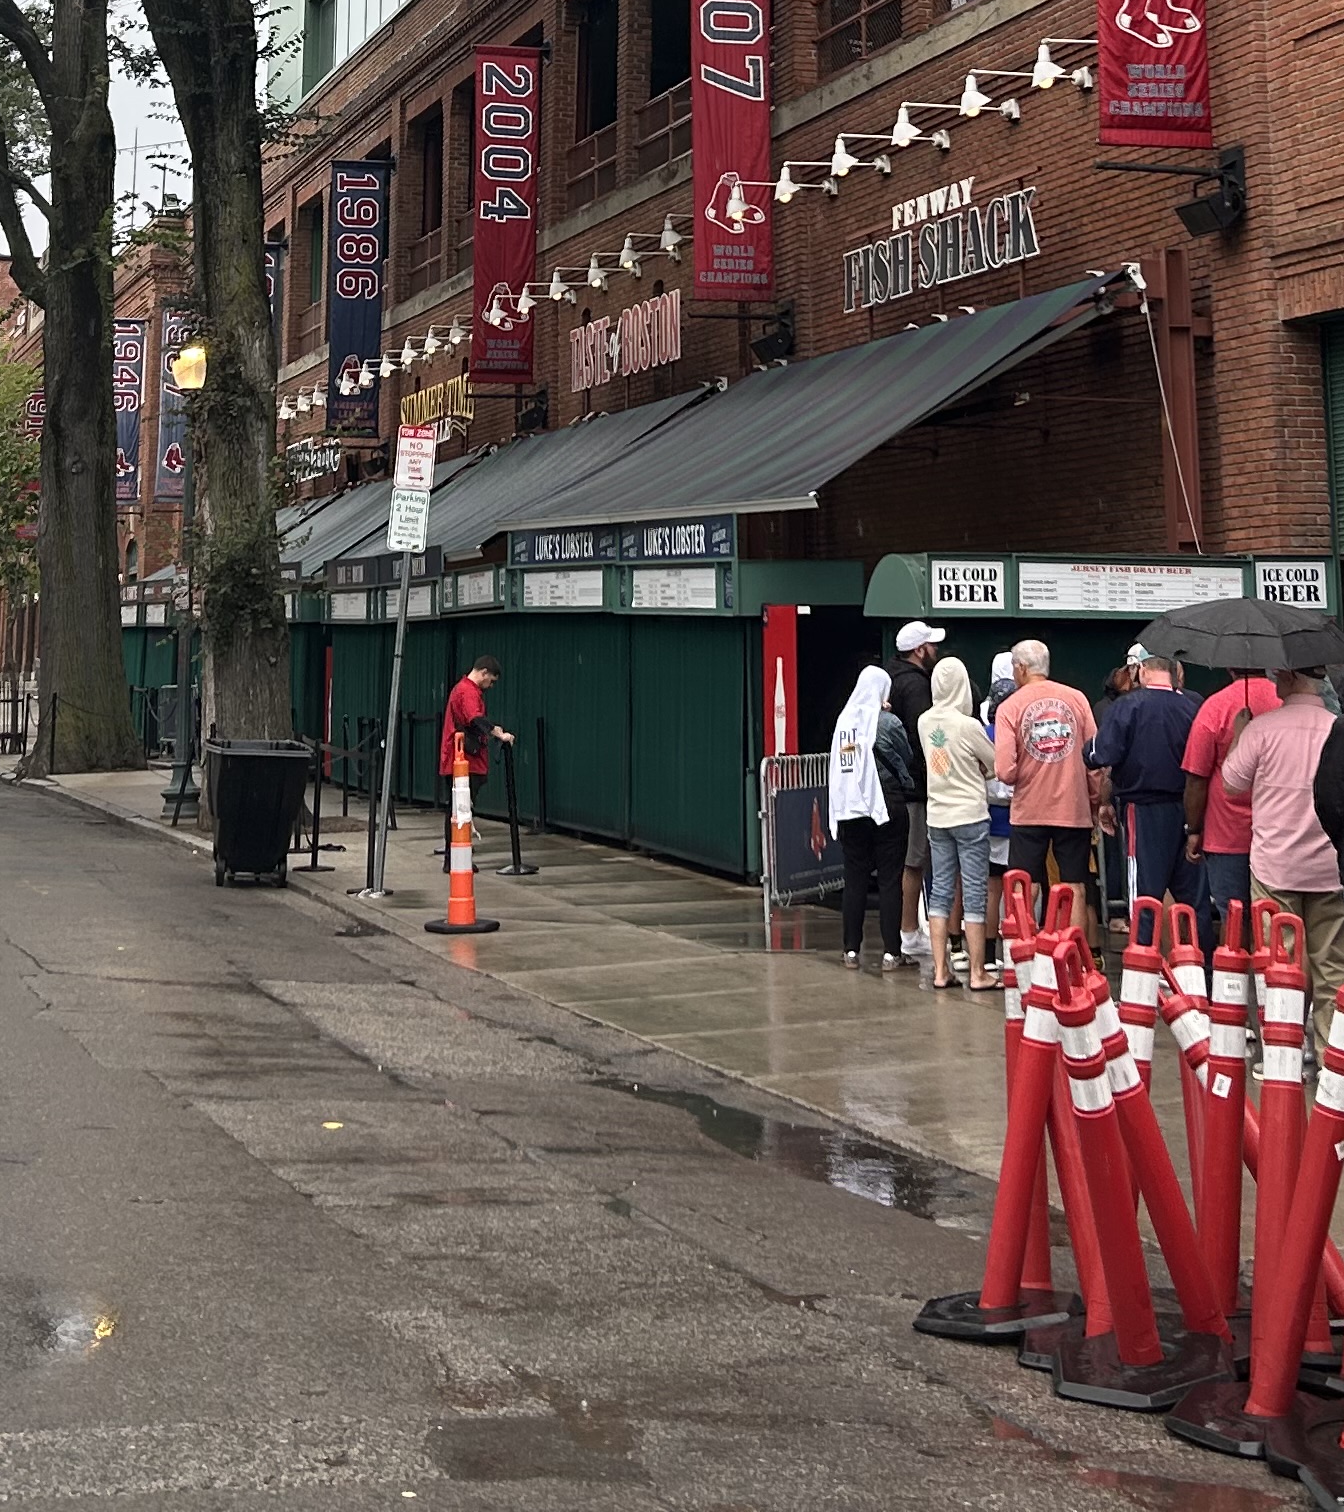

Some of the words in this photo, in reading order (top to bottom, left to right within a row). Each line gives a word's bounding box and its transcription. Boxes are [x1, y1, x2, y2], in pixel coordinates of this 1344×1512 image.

[1125, 62, 1186, 81] WORLD
[1126, 80, 1186, 99] SERIES
[1108, 98, 1204, 119] CHAMPIONS
[480, 61, 534, 223] 2004
[891, 176, 977, 231] FENWAY
[334, 171, 381, 301] 1986
[712, 243, 755, 259] WORLD
[842, 228, 913, 314] FISH
[918, 186, 1041, 286] SHACK
[712, 257, 754, 272] SERIES
[698, 270, 768, 286] CHAMPIONS
[569, 318, 611, 394] TASTE
[622, 287, 682, 378] BOSTON
[400, 383, 444, 426] SUMMER
[446, 374, 475, 424] TIME
[417, 428, 434, 438] ZONE
[400, 450, 432, 459] STOPPING
[409, 442, 424, 451] NO
[407, 466, 422, 474] TIME
[408, 458, 422, 466] ANY
[395, 492, 427, 505] Parking
[396, 504, 402, 513] 2
[405, 504, 425, 514] Hour
[399, 514, 420, 524] Limit
[534, 533, 560, 561] LUKE'S
[561, 530, 594, 560] LOBSTER
[643, 527, 670, 557] LUKE'S
[671, 523, 706, 555] LOBSTER
[938, 566, 960, 583] ICE
[962, 566, 998, 583] COLD
[1071, 564, 1107, 575] JERSEY
[1108, 565, 1131, 576] FISH
[1132, 565, 1164, 576] DRAFT
[1166, 565, 1193, 576] BEER
[1262, 567, 1284, 583] ICE
[1285, 567, 1320, 584] COLD
[938, 583, 999, 603] BEER
[1263, 584, 1321, 603] BEER
[840, 727, 858, 746] PIT
